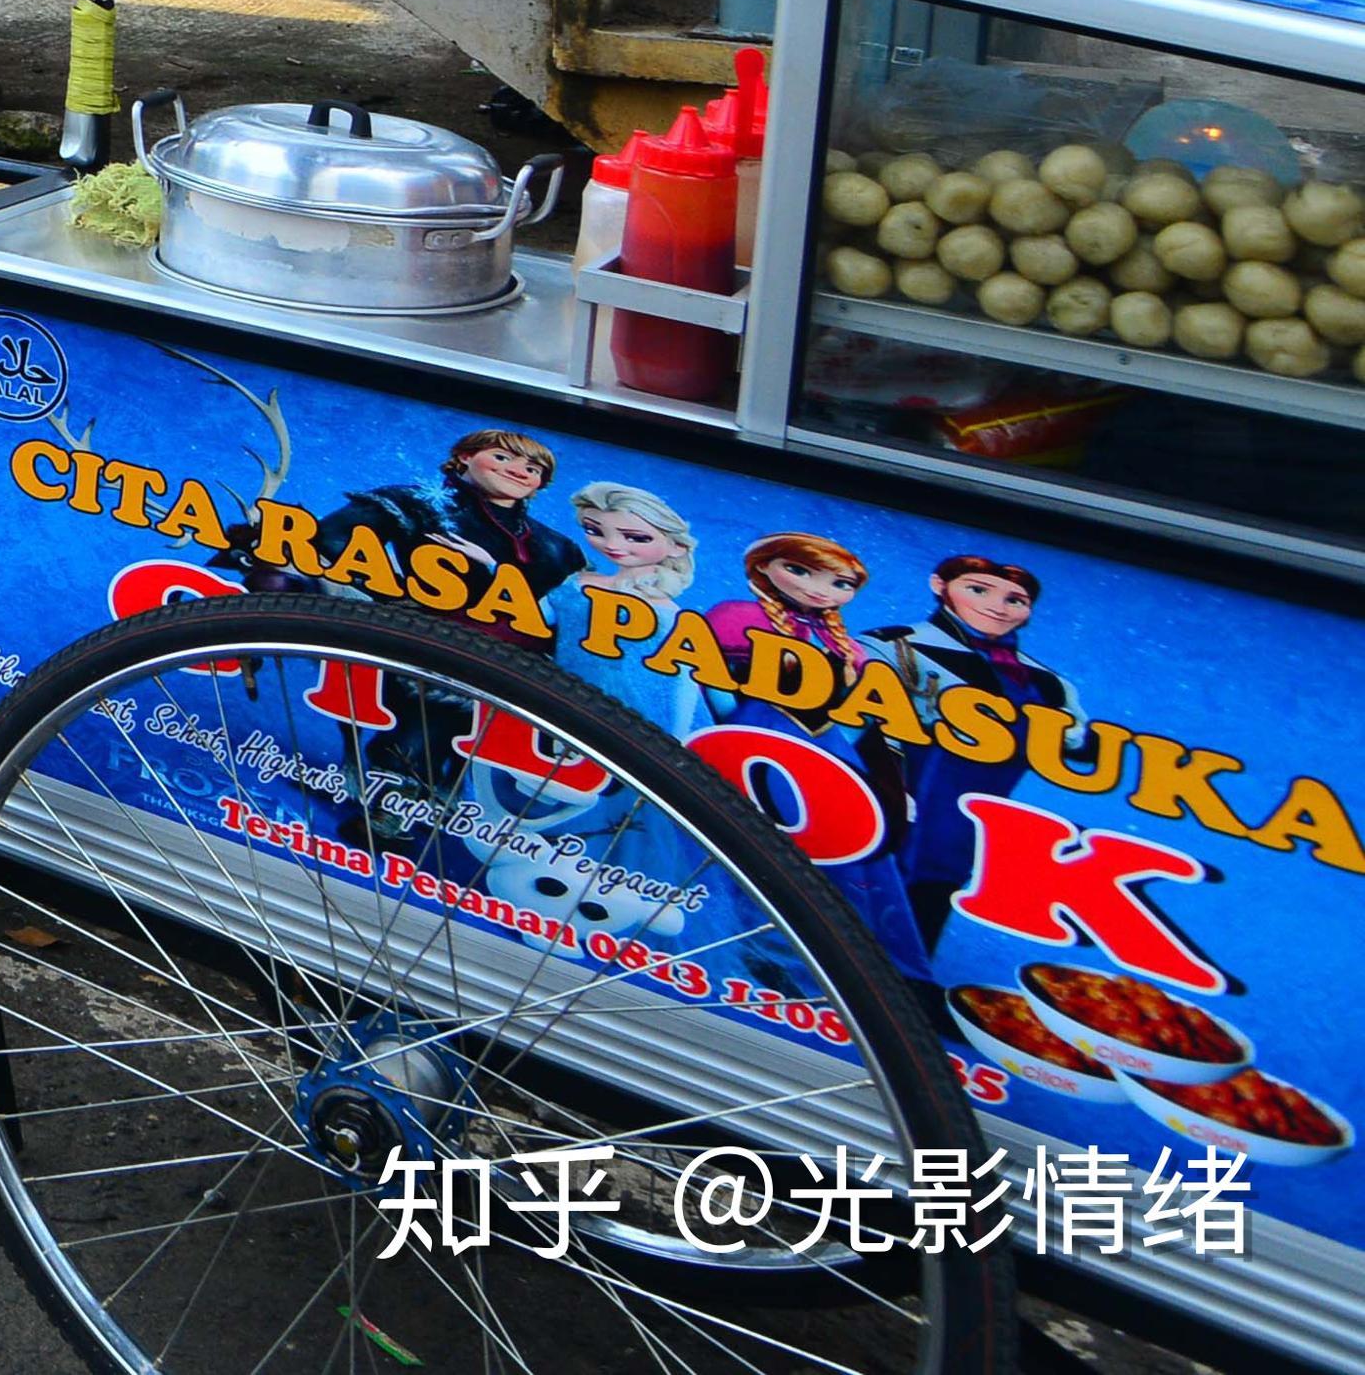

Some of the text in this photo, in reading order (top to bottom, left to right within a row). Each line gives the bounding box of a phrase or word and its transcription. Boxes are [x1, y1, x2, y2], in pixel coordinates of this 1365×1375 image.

[11, 440, 1365, 875] CITA RASA PADASUKA
[145, 704, 228, 764] Sehat,
[236, 730, 349, 803] Higienis,
[361, 771, 443, 832] Tanpa
[446, 801, 542, 861] Bahan
[219, 797, 373, 876] Terima
[383, 852, 578, 949] Pesanan
[586, 928, 713, 999] 0813
[720, 977, 854, 1046] 1108
